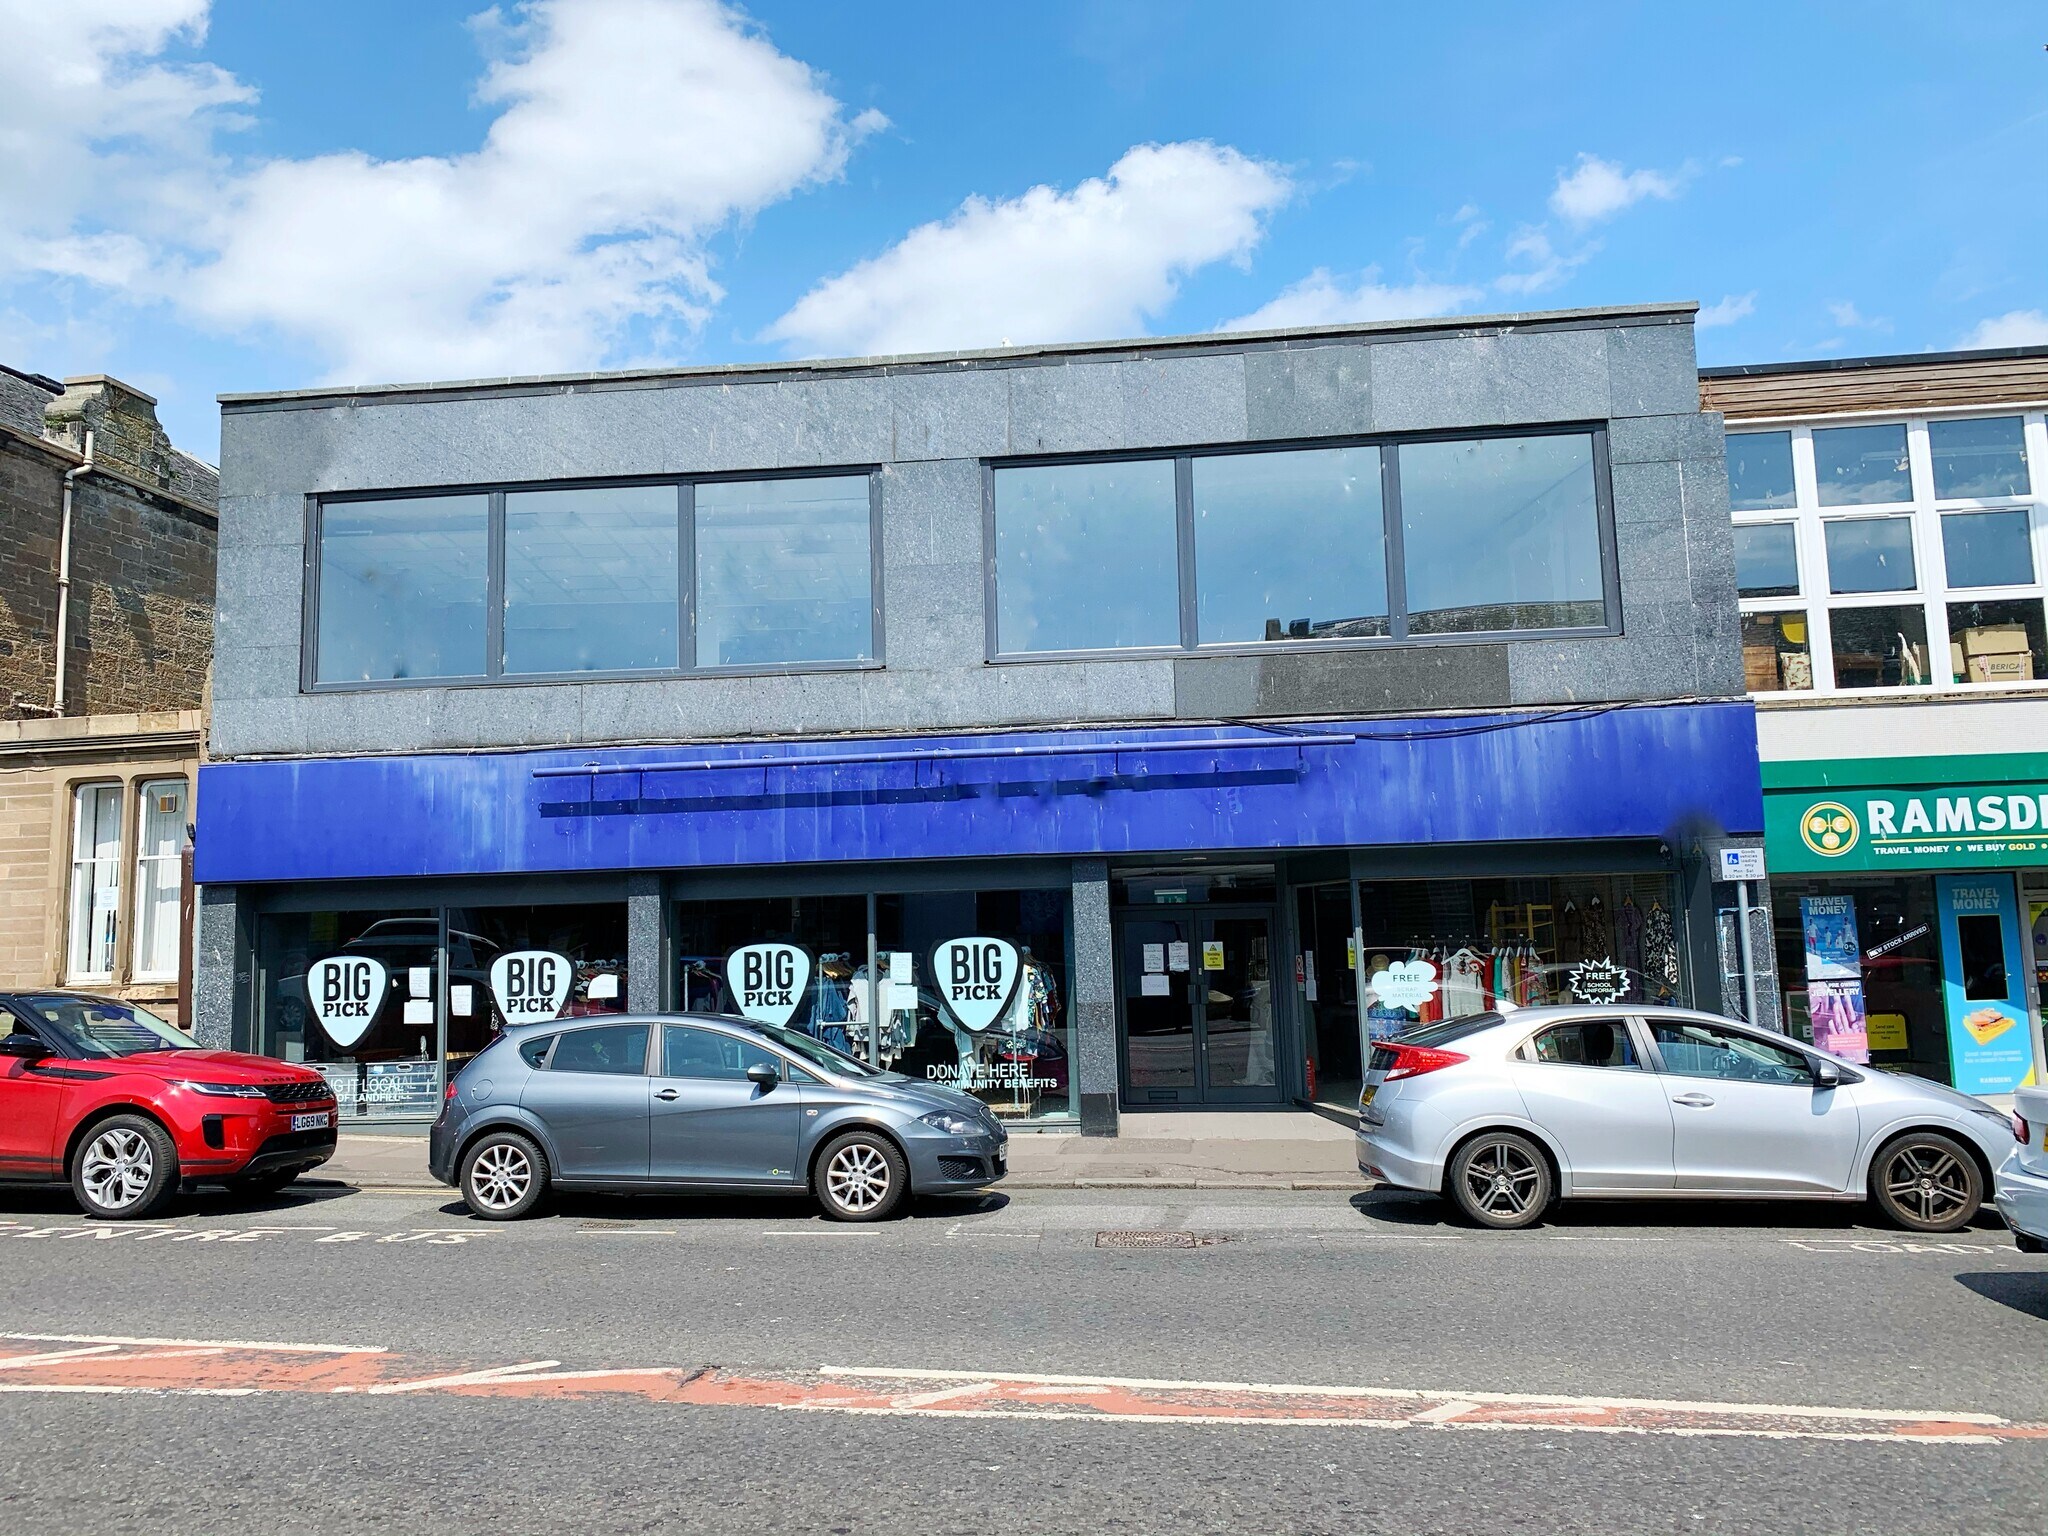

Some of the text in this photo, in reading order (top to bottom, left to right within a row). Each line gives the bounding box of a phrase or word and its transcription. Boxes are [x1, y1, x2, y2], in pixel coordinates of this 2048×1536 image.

[1990, 662, 2026, 670] BERICA
[1873, 843, 2036, 855] TRAVEL MONEY WE BUY GOLD
[1952, 888, 2000, 899] TRAVEL
[1807, 896, 1847, 906] TRAVEL
[1952, 898, 2000, 910] MONEY
[1808, 905, 1847, 915] MONEY
[1869, 925, 1927, 957] NEW STOCK ARRIVED
[744, 949, 793, 990] BIG
[951, 943, 1002, 985] BIG
[324, 962, 370, 1002] BIG
[507, 956, 556, 997] BIG
[1392, 974, 1420, 982] FREE
[1585, 972, 1612, 980] FREE
[744, 990, 793, 1007] PICK
[951, 985, 1001, 1001] PICK
[1811, 988, 1860, 997] JEWELLERY
[323, 1002, 369, 1018] PICK
[506, 997, 555, 1013] PICK
[926, 1062, 1029, 1079] DONATE HERE
[347, 1079, 359, 1093] IT
[362, 1079, 403, 1092] LOCAL
[1004, 1078, 1058, 1089] BENEFITS
[296, 1115, 315, 1129] LG69
